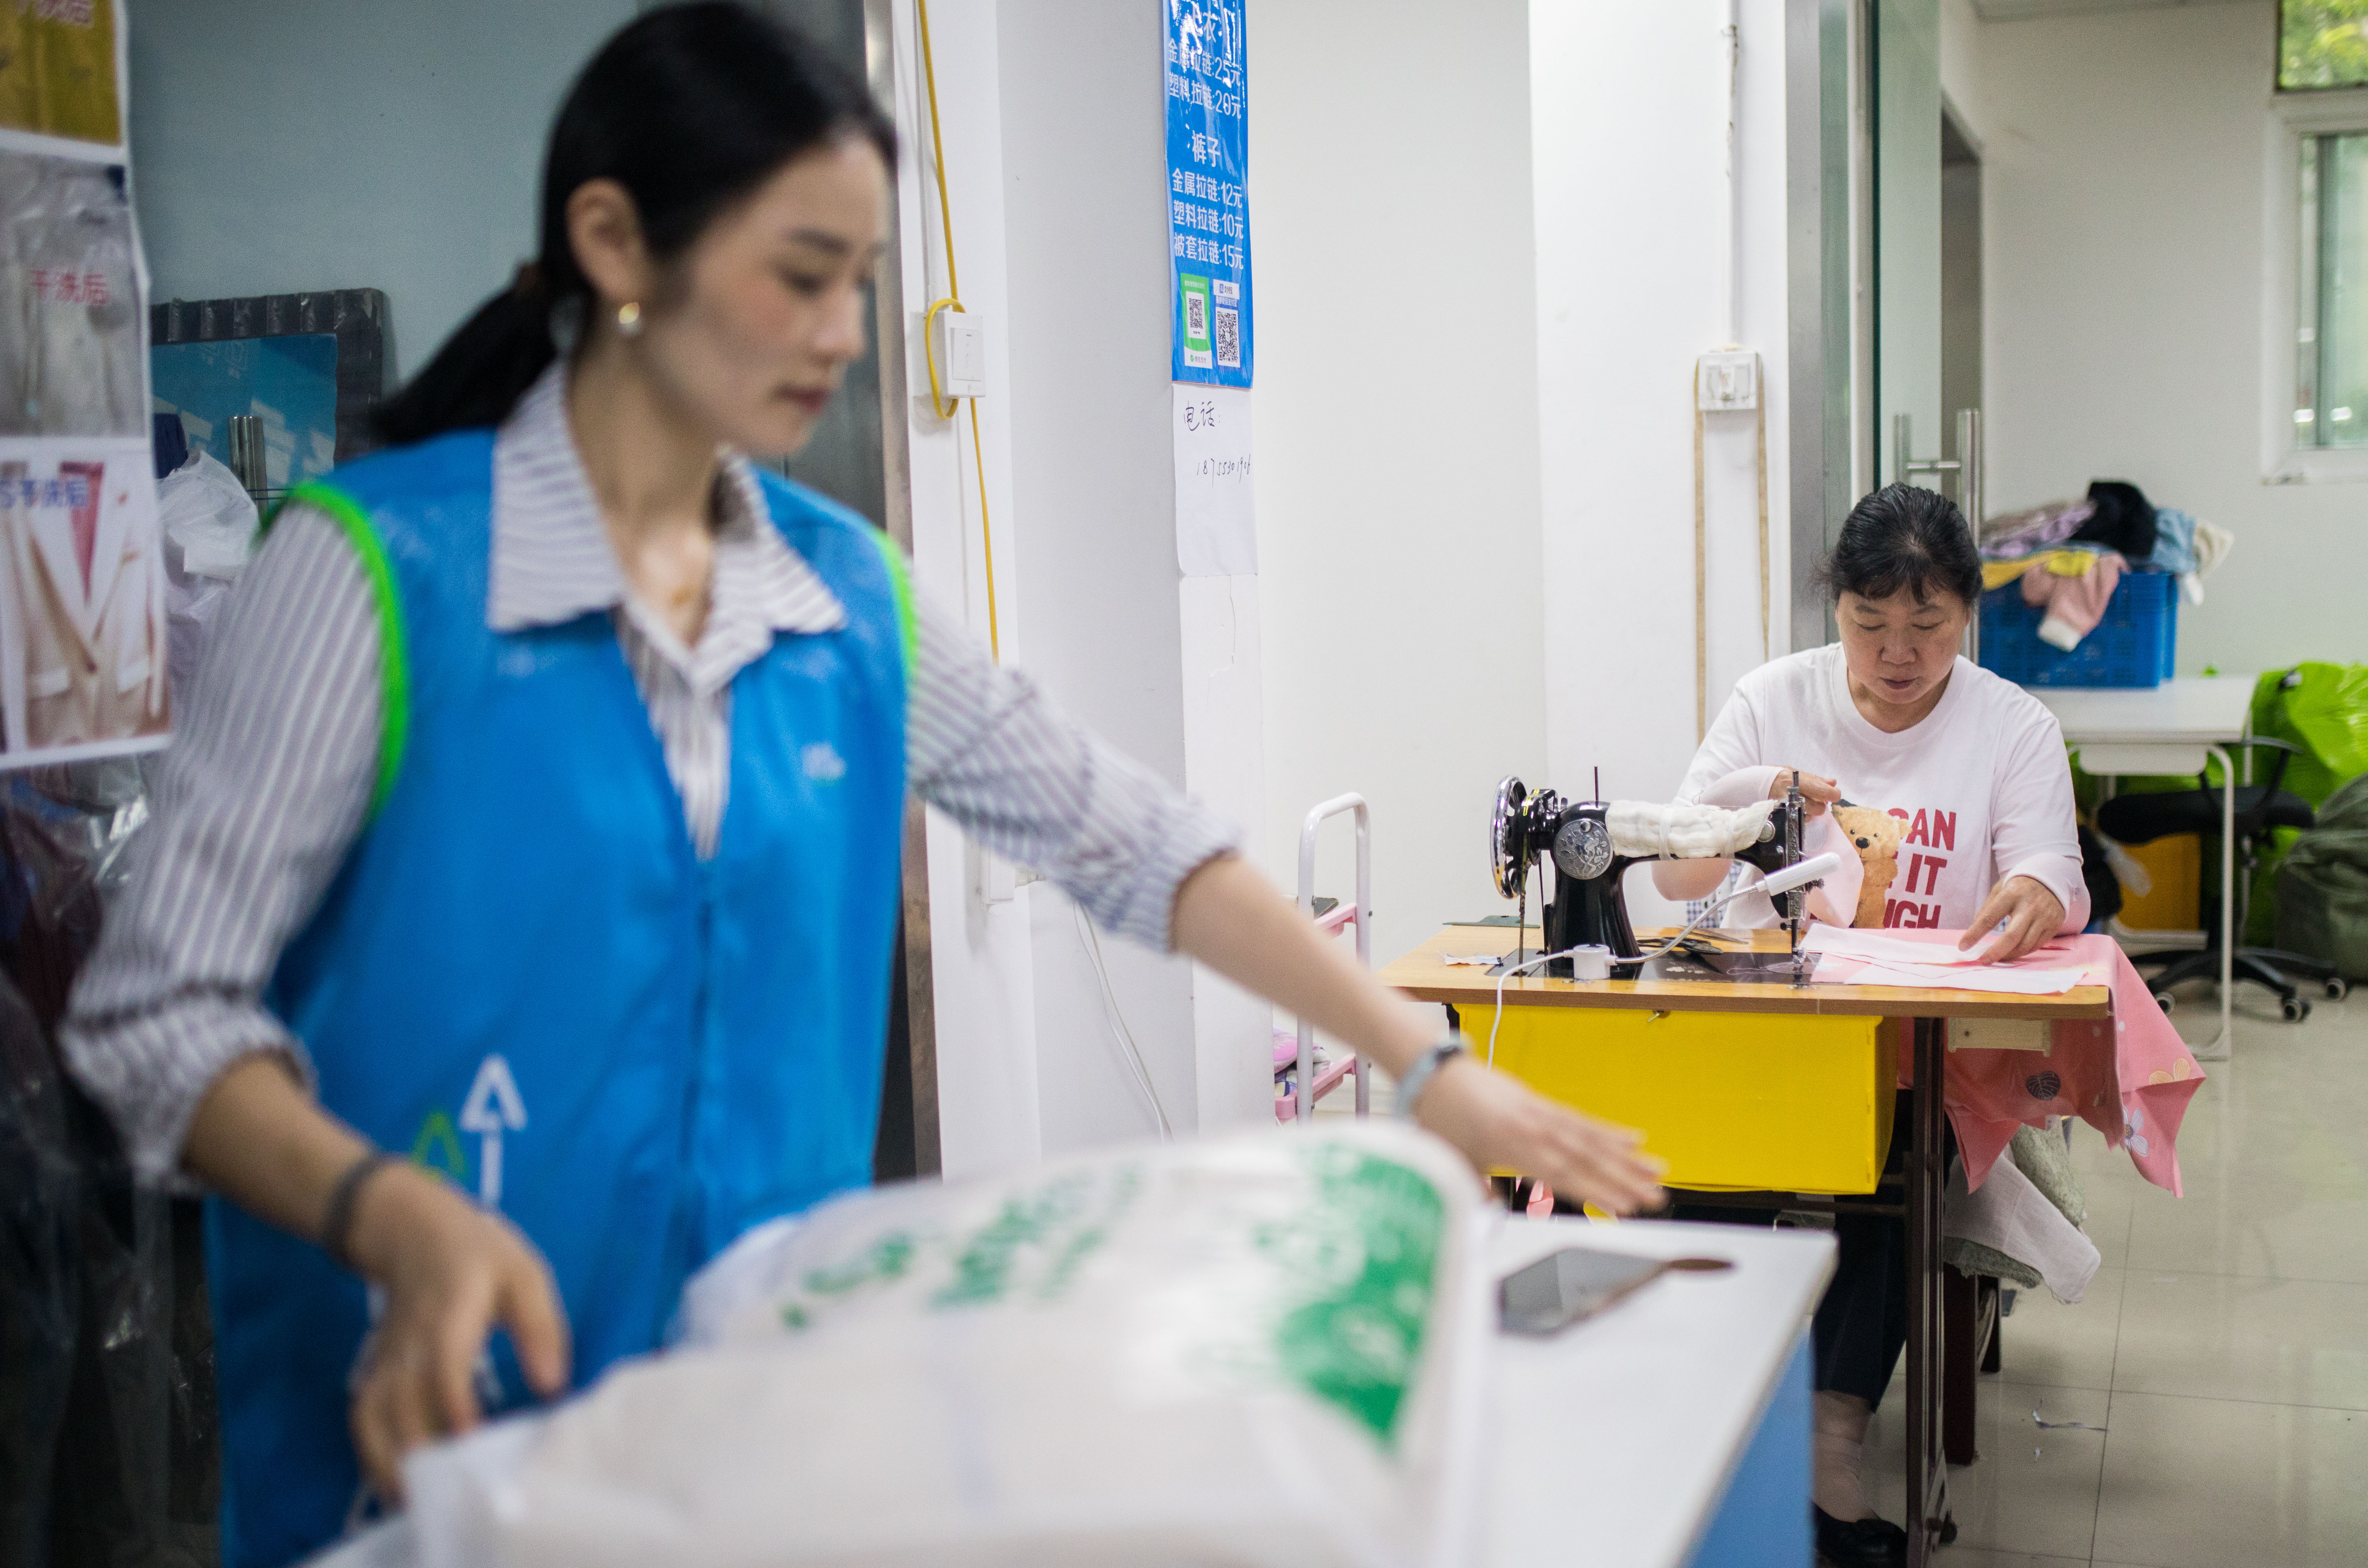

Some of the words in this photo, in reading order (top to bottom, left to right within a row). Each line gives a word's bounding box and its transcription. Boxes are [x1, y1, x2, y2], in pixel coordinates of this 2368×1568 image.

[1169, 72, 1242, 119] 塑料拉链:20元
[1192, 130, 1219, 167] 裤子
[1172, 167, 1242, 208] 金属拉链:12元
[1174, 200, 1244, 239] 塑料拉链:10元
[1174, 232, 1244, 270] 被套拉链:15元
[1905, 853, 1947, 896] IT
